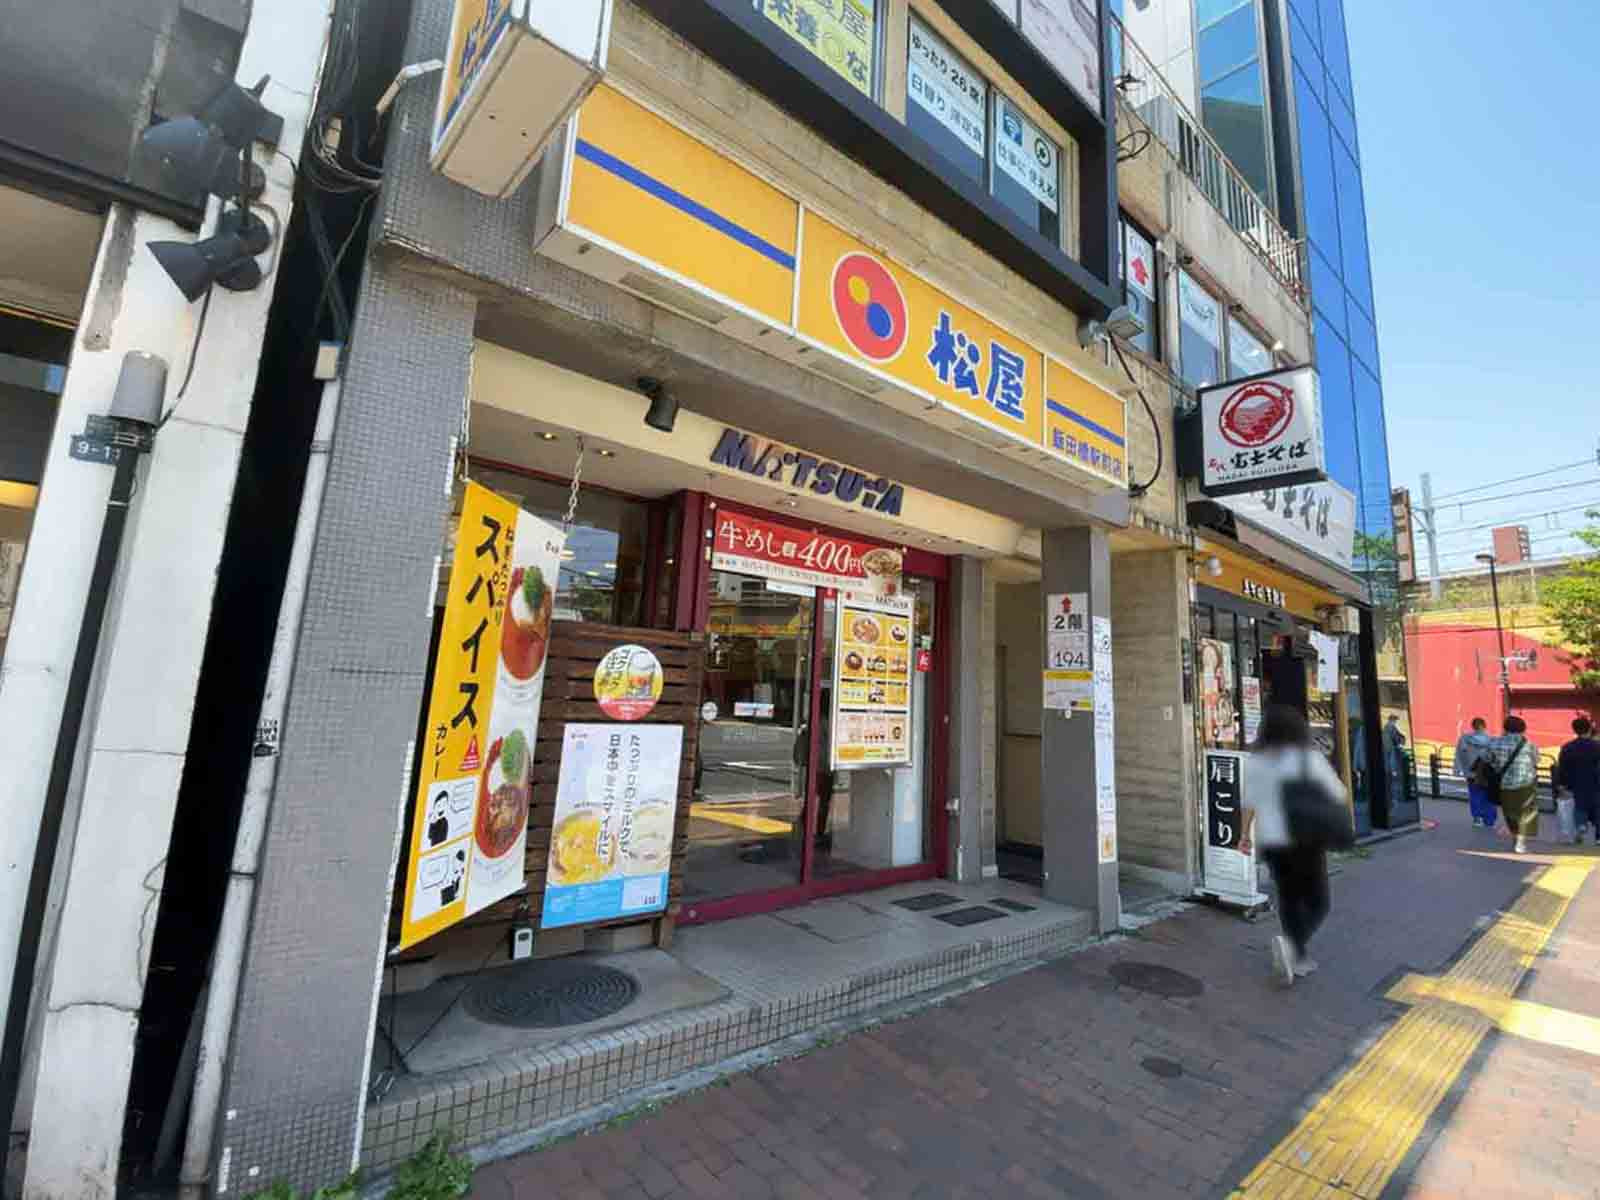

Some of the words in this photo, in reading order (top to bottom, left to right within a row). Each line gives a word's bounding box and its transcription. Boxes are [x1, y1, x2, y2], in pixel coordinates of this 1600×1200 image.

[927, 311, 1025, 421] 松屋
[451, 515, 501, 730] スパイス
[433, 722, 448, 779] カレー
[1209, 758, 1235, 846] 肩こり
